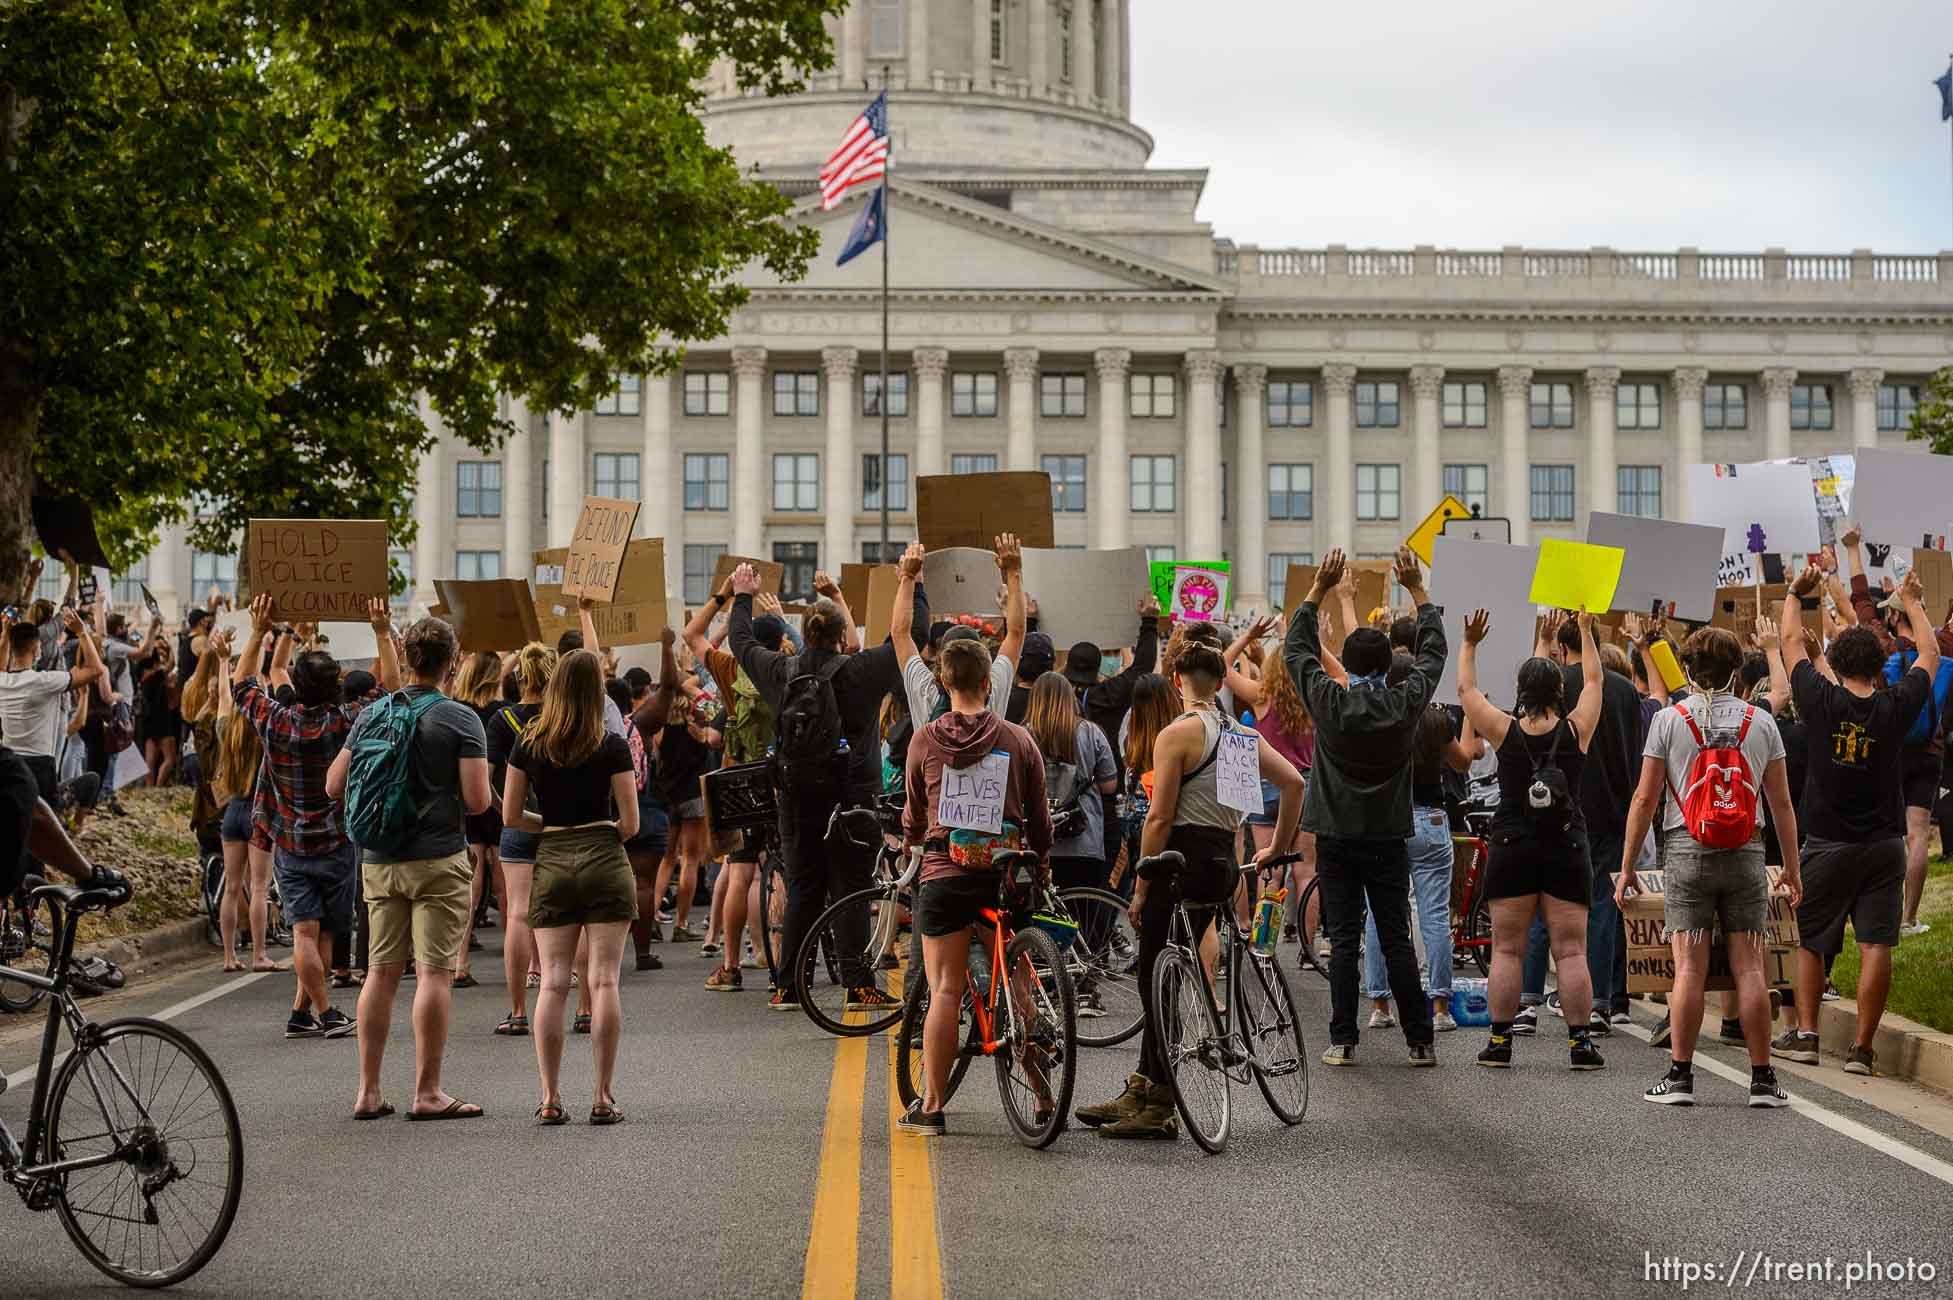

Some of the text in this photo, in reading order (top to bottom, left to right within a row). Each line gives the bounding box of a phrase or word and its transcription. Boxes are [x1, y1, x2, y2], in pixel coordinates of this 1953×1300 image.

[575, 505, 630, 545] DEFUND
[259, 527, 339, 559] HOLD
[257, 559, 353, 585] POLICE
[568, 552, 585, 586] THE
[945, 772, 1000, 800] LIVES
[1218, 767, 1257, 788] LIVES
[940, 800, 1000, 825] MATTER
